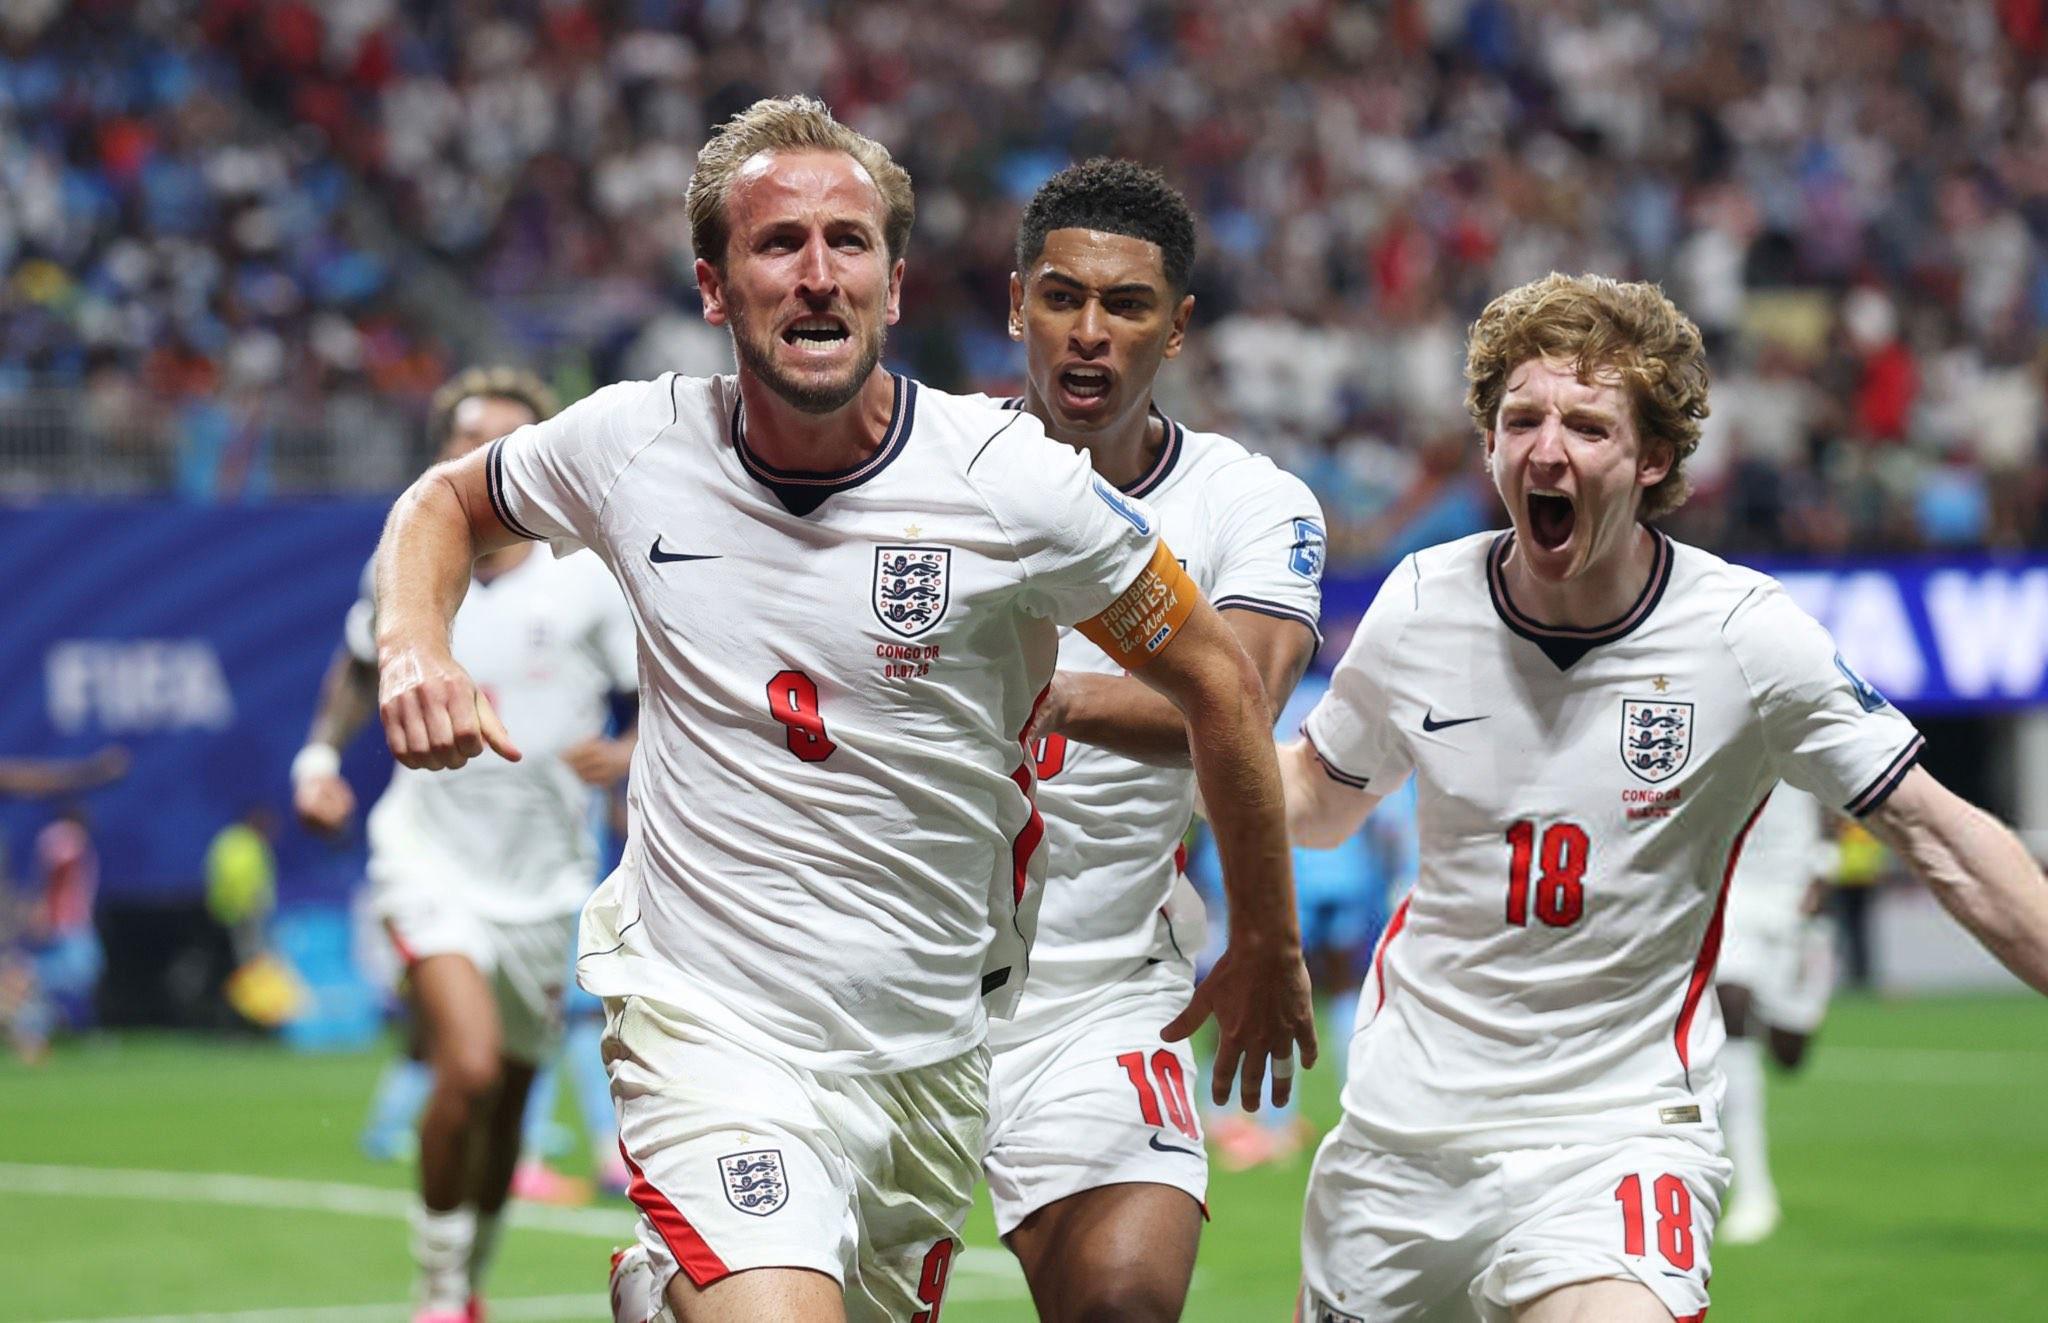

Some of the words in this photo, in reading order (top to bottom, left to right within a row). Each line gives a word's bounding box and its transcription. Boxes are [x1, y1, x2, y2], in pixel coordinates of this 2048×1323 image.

[1100, 567, 1159, 628] FOOTBALL
[1108, 576, 1168, 640] UNITES
[1119, 634, 1143, 655] the
[1142, 589, 1178, 637] World
[876, 644, 921, 660] CONGO
[924, 645, 940, 659] DR
[1147, 625, 1171, 651] FIFA
[884, 664, 929, 678] 01.07.26
[765, 669, 838, 764] 9
[1622, 789, 1664, 803] CONGO
[1505, 819, 1590, 928] 18
[1116, 1048, 1200, 1141] 10
[1614, 1172, 1695, 1272] 18
[910, 1236, 955, 1323] 9
